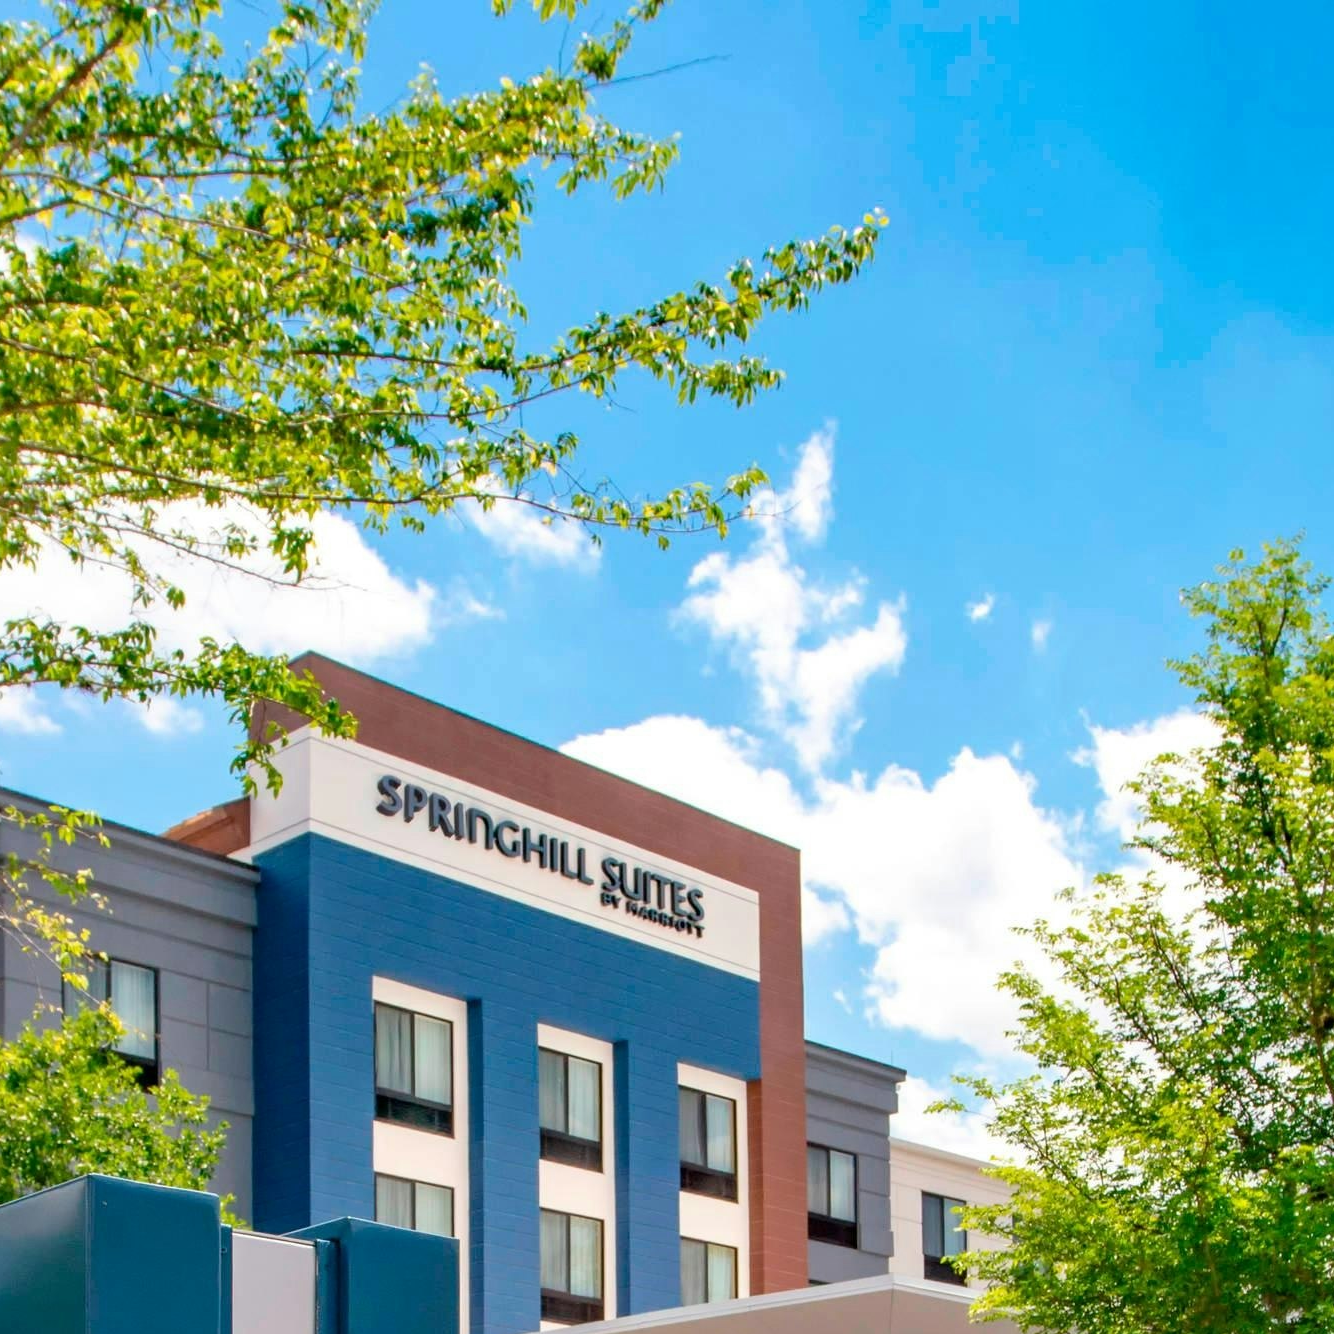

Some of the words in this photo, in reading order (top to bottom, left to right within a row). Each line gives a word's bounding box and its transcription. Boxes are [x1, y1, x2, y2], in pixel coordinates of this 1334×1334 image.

[376, 774, 594, 886] SPRINGHILL
[601, 857, 705, 922] SUITES
[600, 892, 621, 909] BY
[625, 900, 705, 938] MARRIOTT
